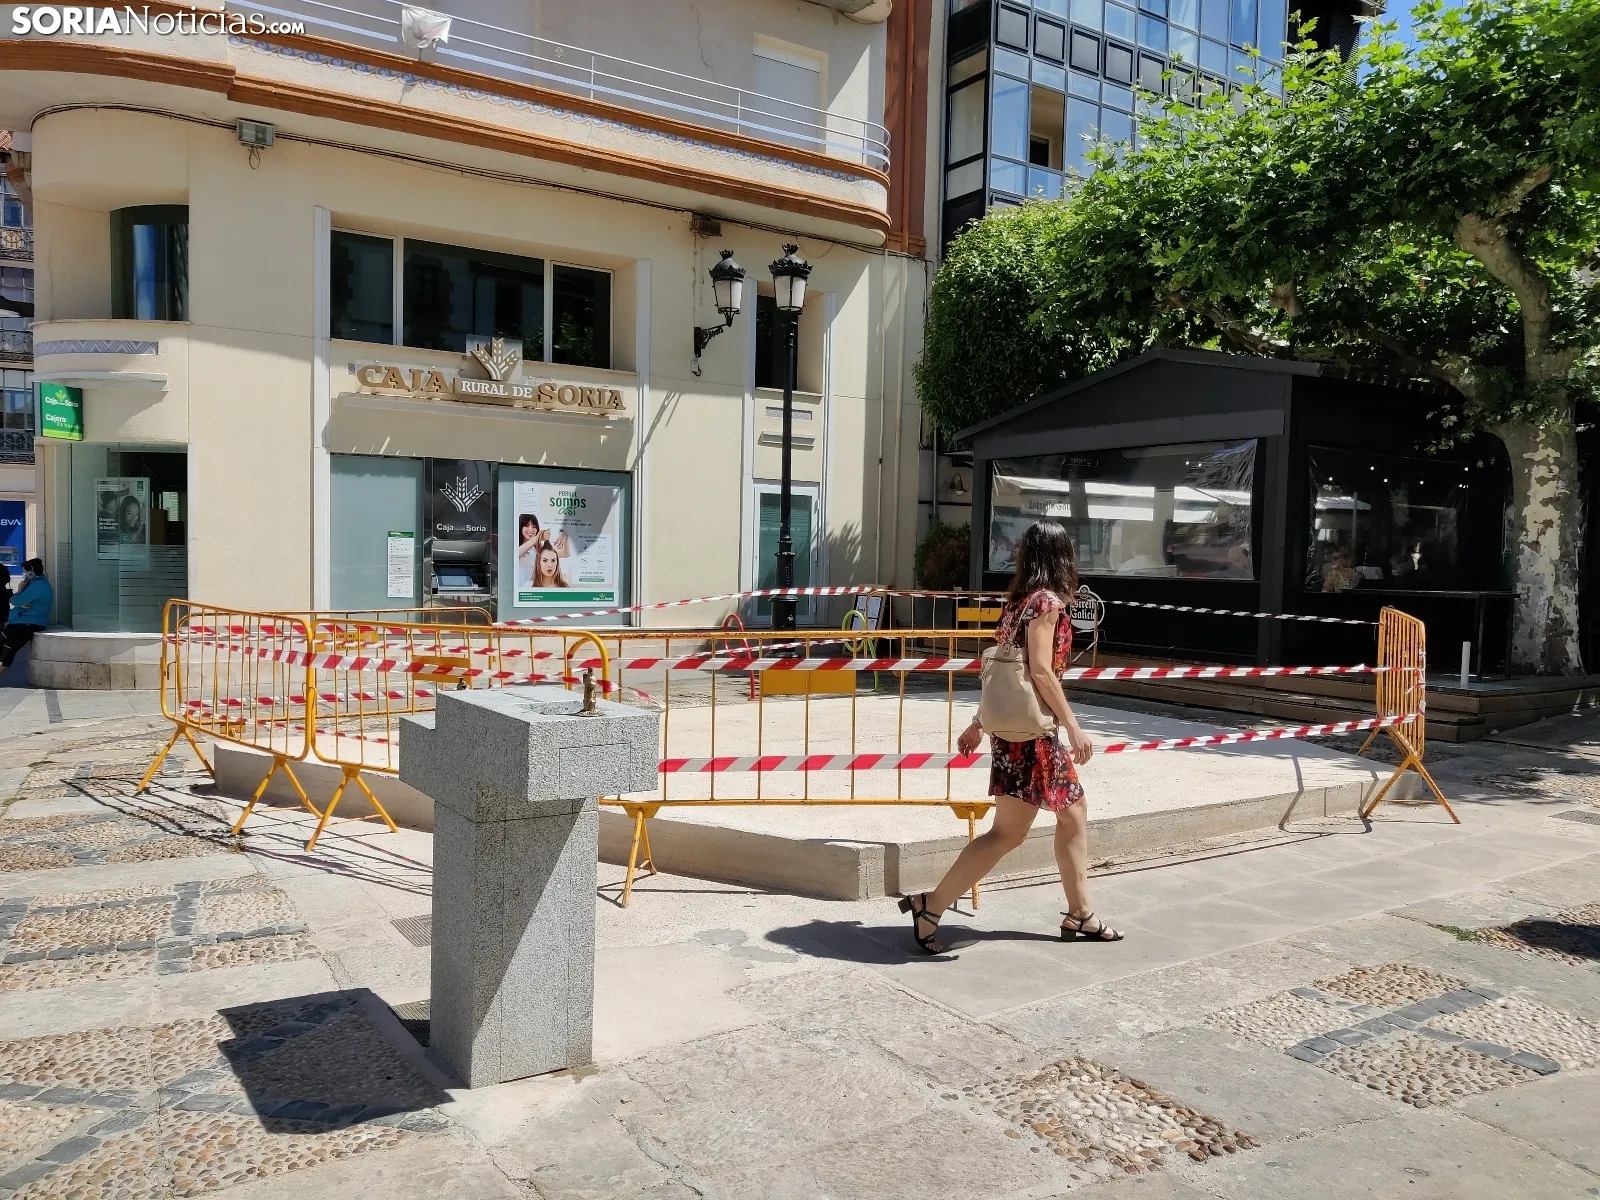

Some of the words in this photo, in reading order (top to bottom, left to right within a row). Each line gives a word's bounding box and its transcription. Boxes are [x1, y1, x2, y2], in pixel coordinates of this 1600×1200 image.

[355, 364, 454, 393] CAJA
[461, 380, 508, 396] RURAL
[513, 386, 533, 399] DE
[538, 382, 626, 410] SORIA
[45, 396, 57, 405] Caja
[45, 413, 66, 423] Cajero
[549, 497, 586, 509] somos
[558, 507, 576, 516] así
[436, 523, 454, 532] Caja
[466, 524, 486, 532] Soria
